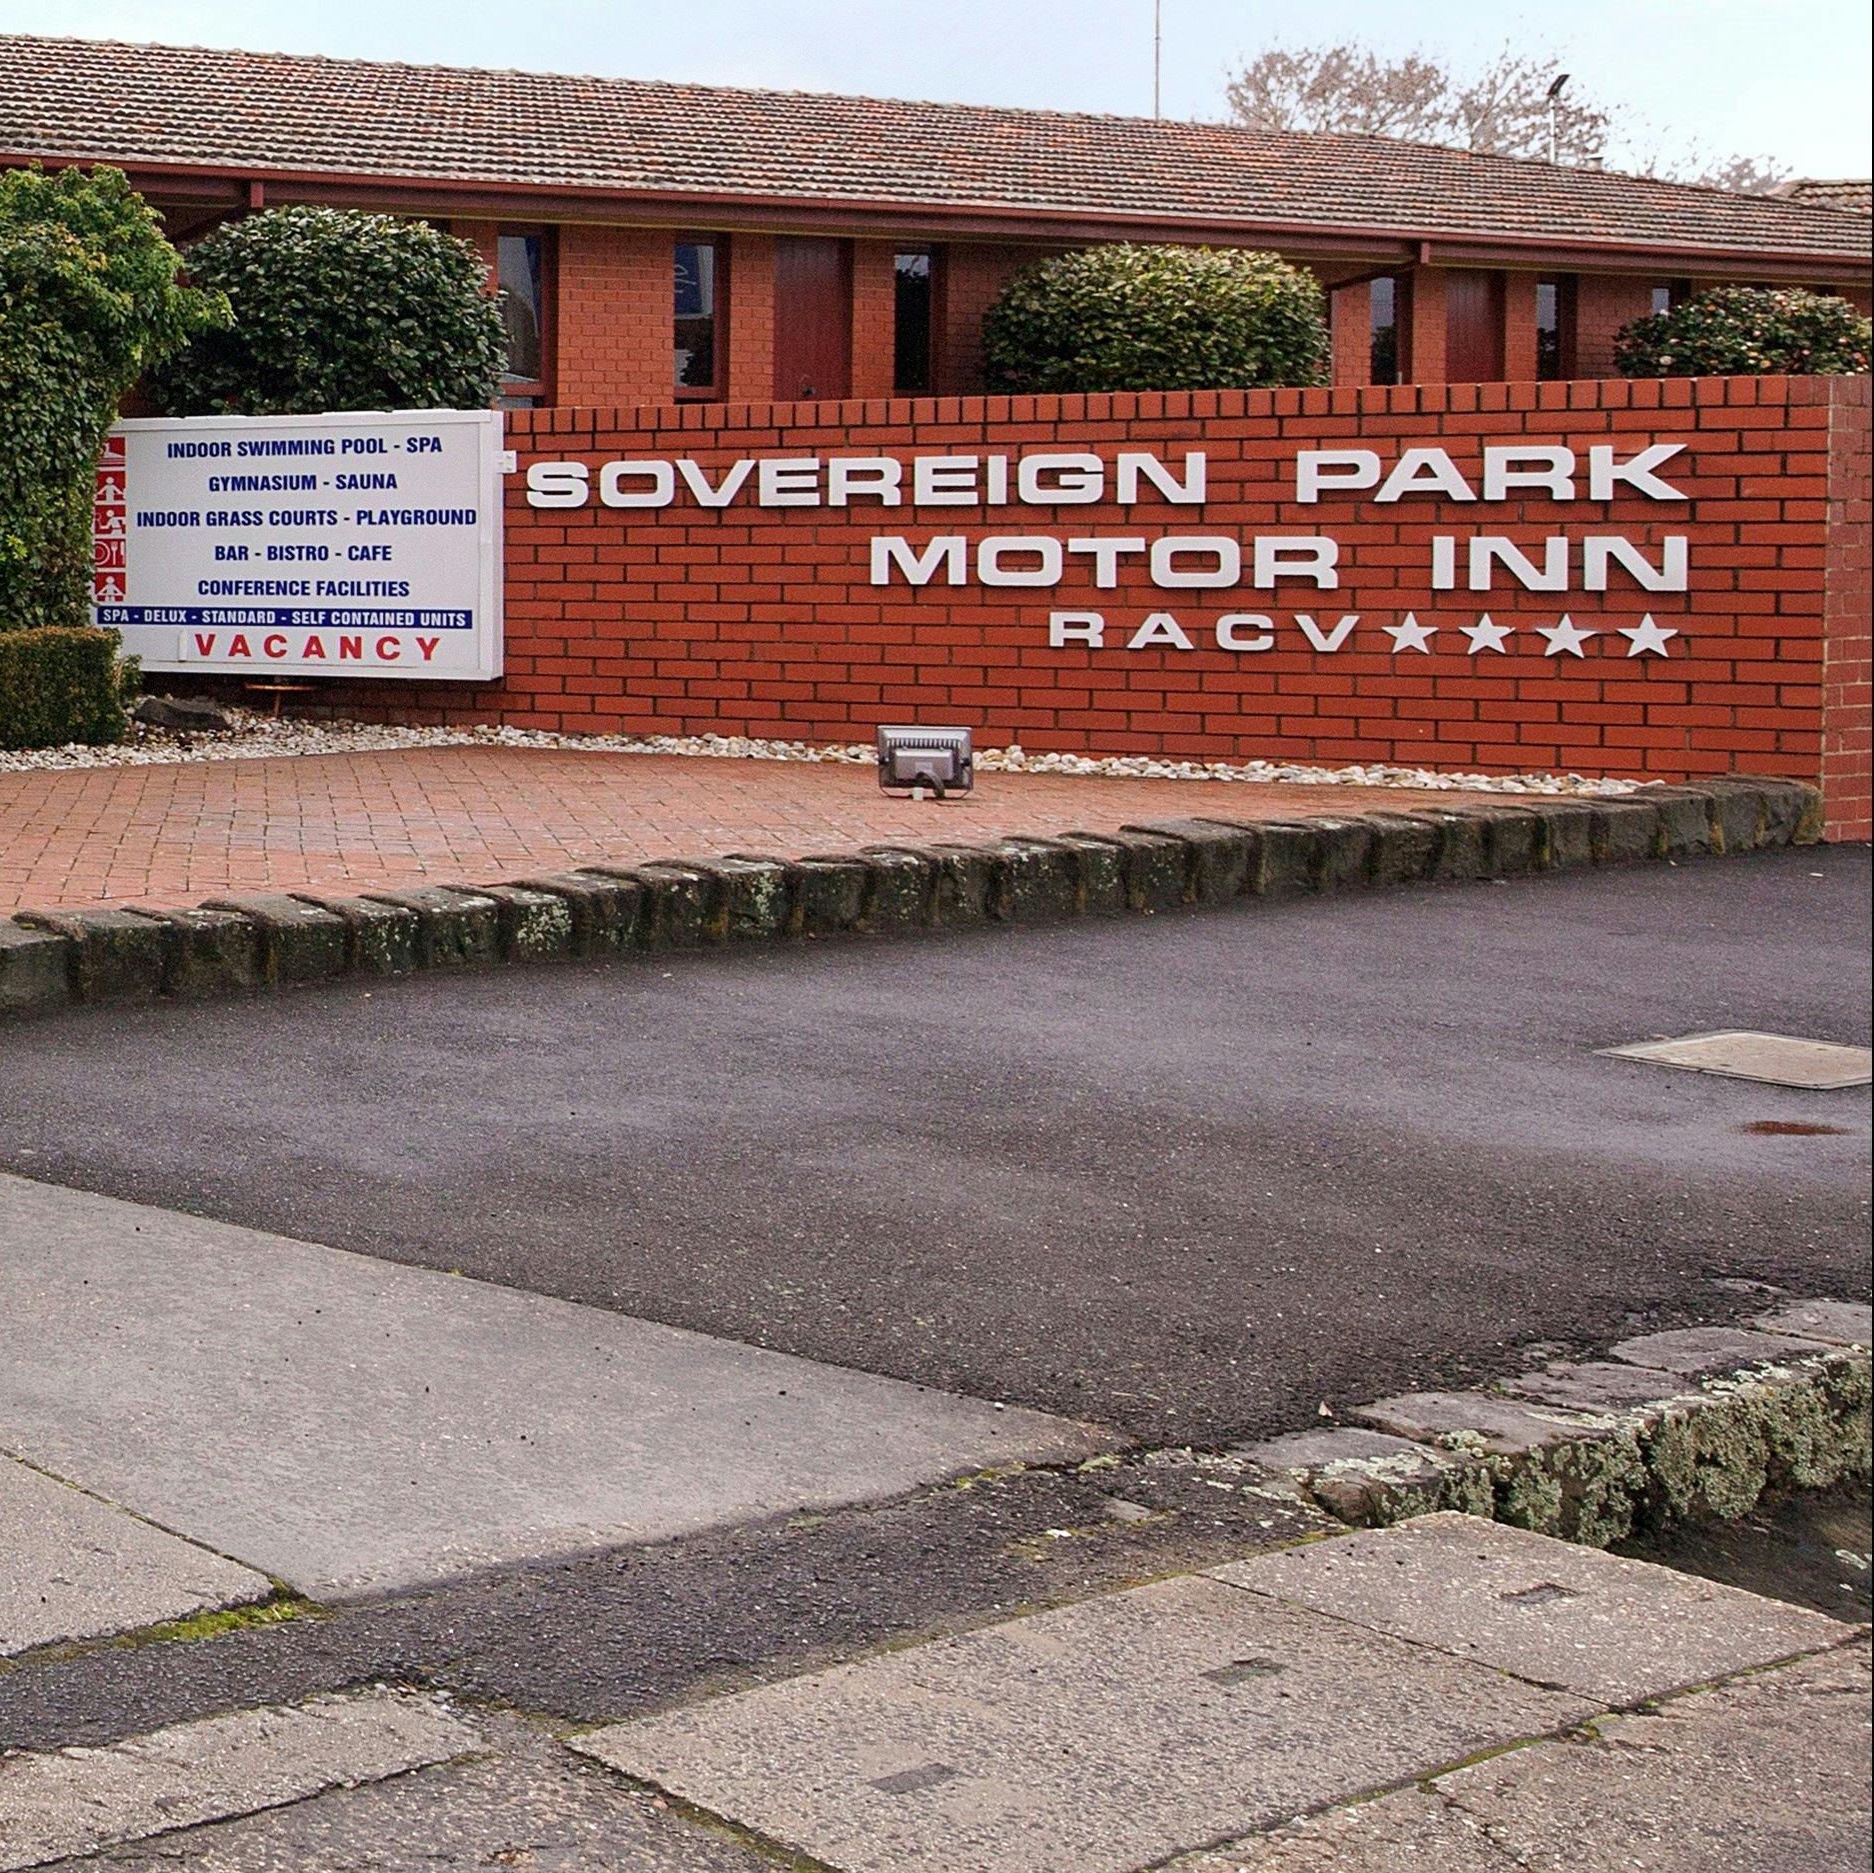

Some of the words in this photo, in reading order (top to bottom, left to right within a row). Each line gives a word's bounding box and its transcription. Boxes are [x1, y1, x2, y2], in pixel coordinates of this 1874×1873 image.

[167, 440, 232, 459] INDOOR
[237, 438, 335, 457] SWIMMING
[341, 437, 388, 456] POOL
[406, 436, 443, 454] SPA
[208, 474, 317, 493] GYMNASIUM
[335, 473, 398, 491] SAUNA
[526, 451, 1207, 508] SOVEREIGN
[1296, 444, 1689, 503] PARK
[136, 510, 201, 528] INDOOR
[205, 509, 264, 527] GRASS
[268, 509, 338, 527] COURTS
[356, 509, 477, 526] PLAYGROUND
[214, 545, 249, 561] BAR
[267, 545, 329, 562] BISTRO
[347, 545, 392, 562] CAFE
[870, 535, 1339, 589] MOTOR
[1432, 536, 1689, 592] INN
[197, 579, 311, 597] CONFERENCE
[316, 580, 410, 598] FACILITIES
[103, 608, 129, 622] SPA
[144, 609, 187, 623] DELUX
[202, 610, 276, 624] STANDARD
[291, 611, 326, 625] SELF
[331, 611, 415, 626] CONTAINED
[420, 612, 466, 627] UNITS
[1049, 611, 1360, 653] RACV
[195, 634, 440, 661] VACANCY
